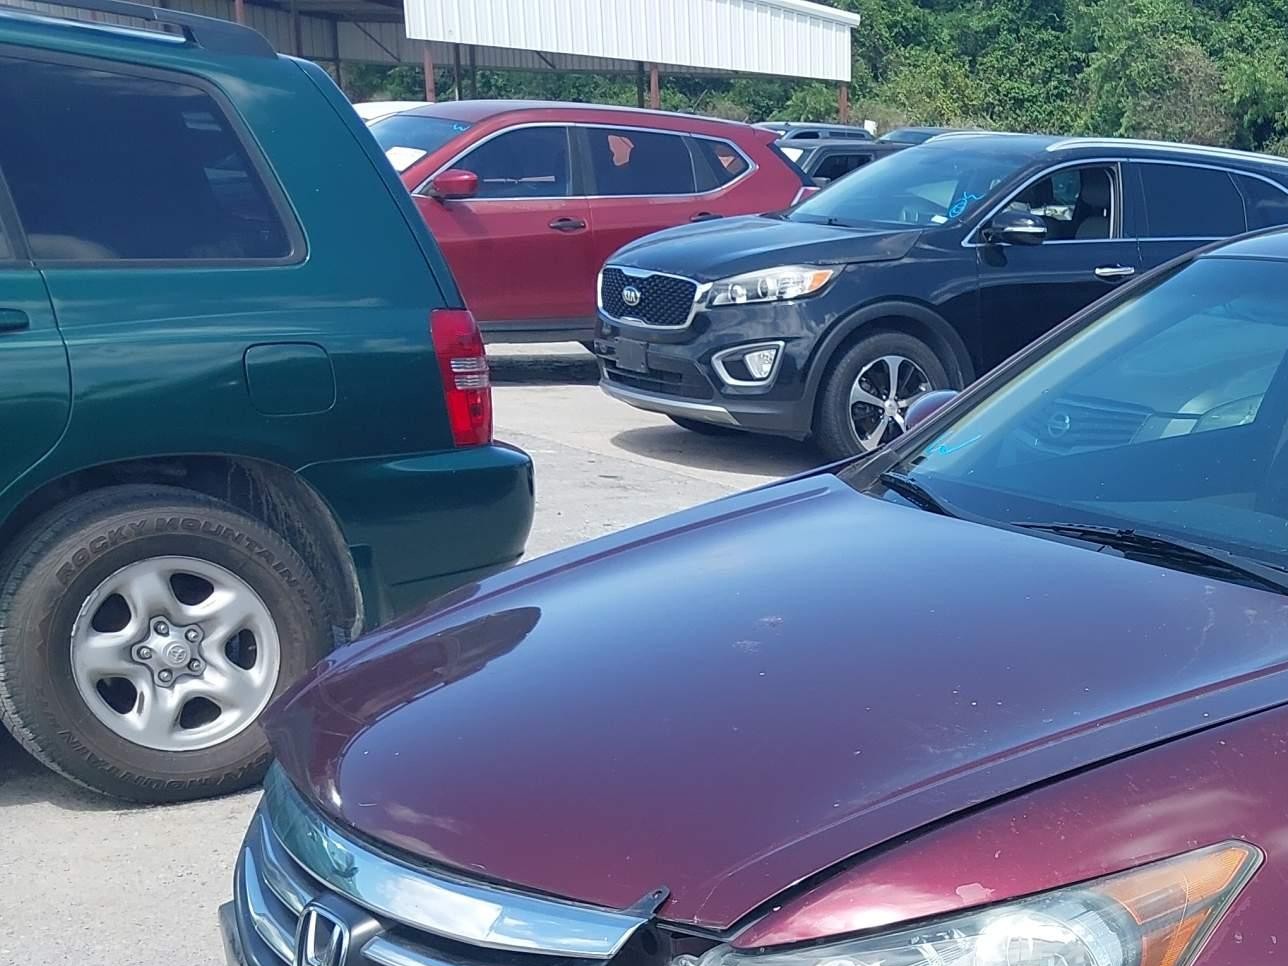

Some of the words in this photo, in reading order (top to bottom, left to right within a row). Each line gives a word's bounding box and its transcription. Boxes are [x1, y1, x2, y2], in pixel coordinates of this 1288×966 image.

[623, 288, 641, 304] KIA
[56, 519, 147, 585] ROCKY
[154, 517, 298, 588] MOUNTAIN
